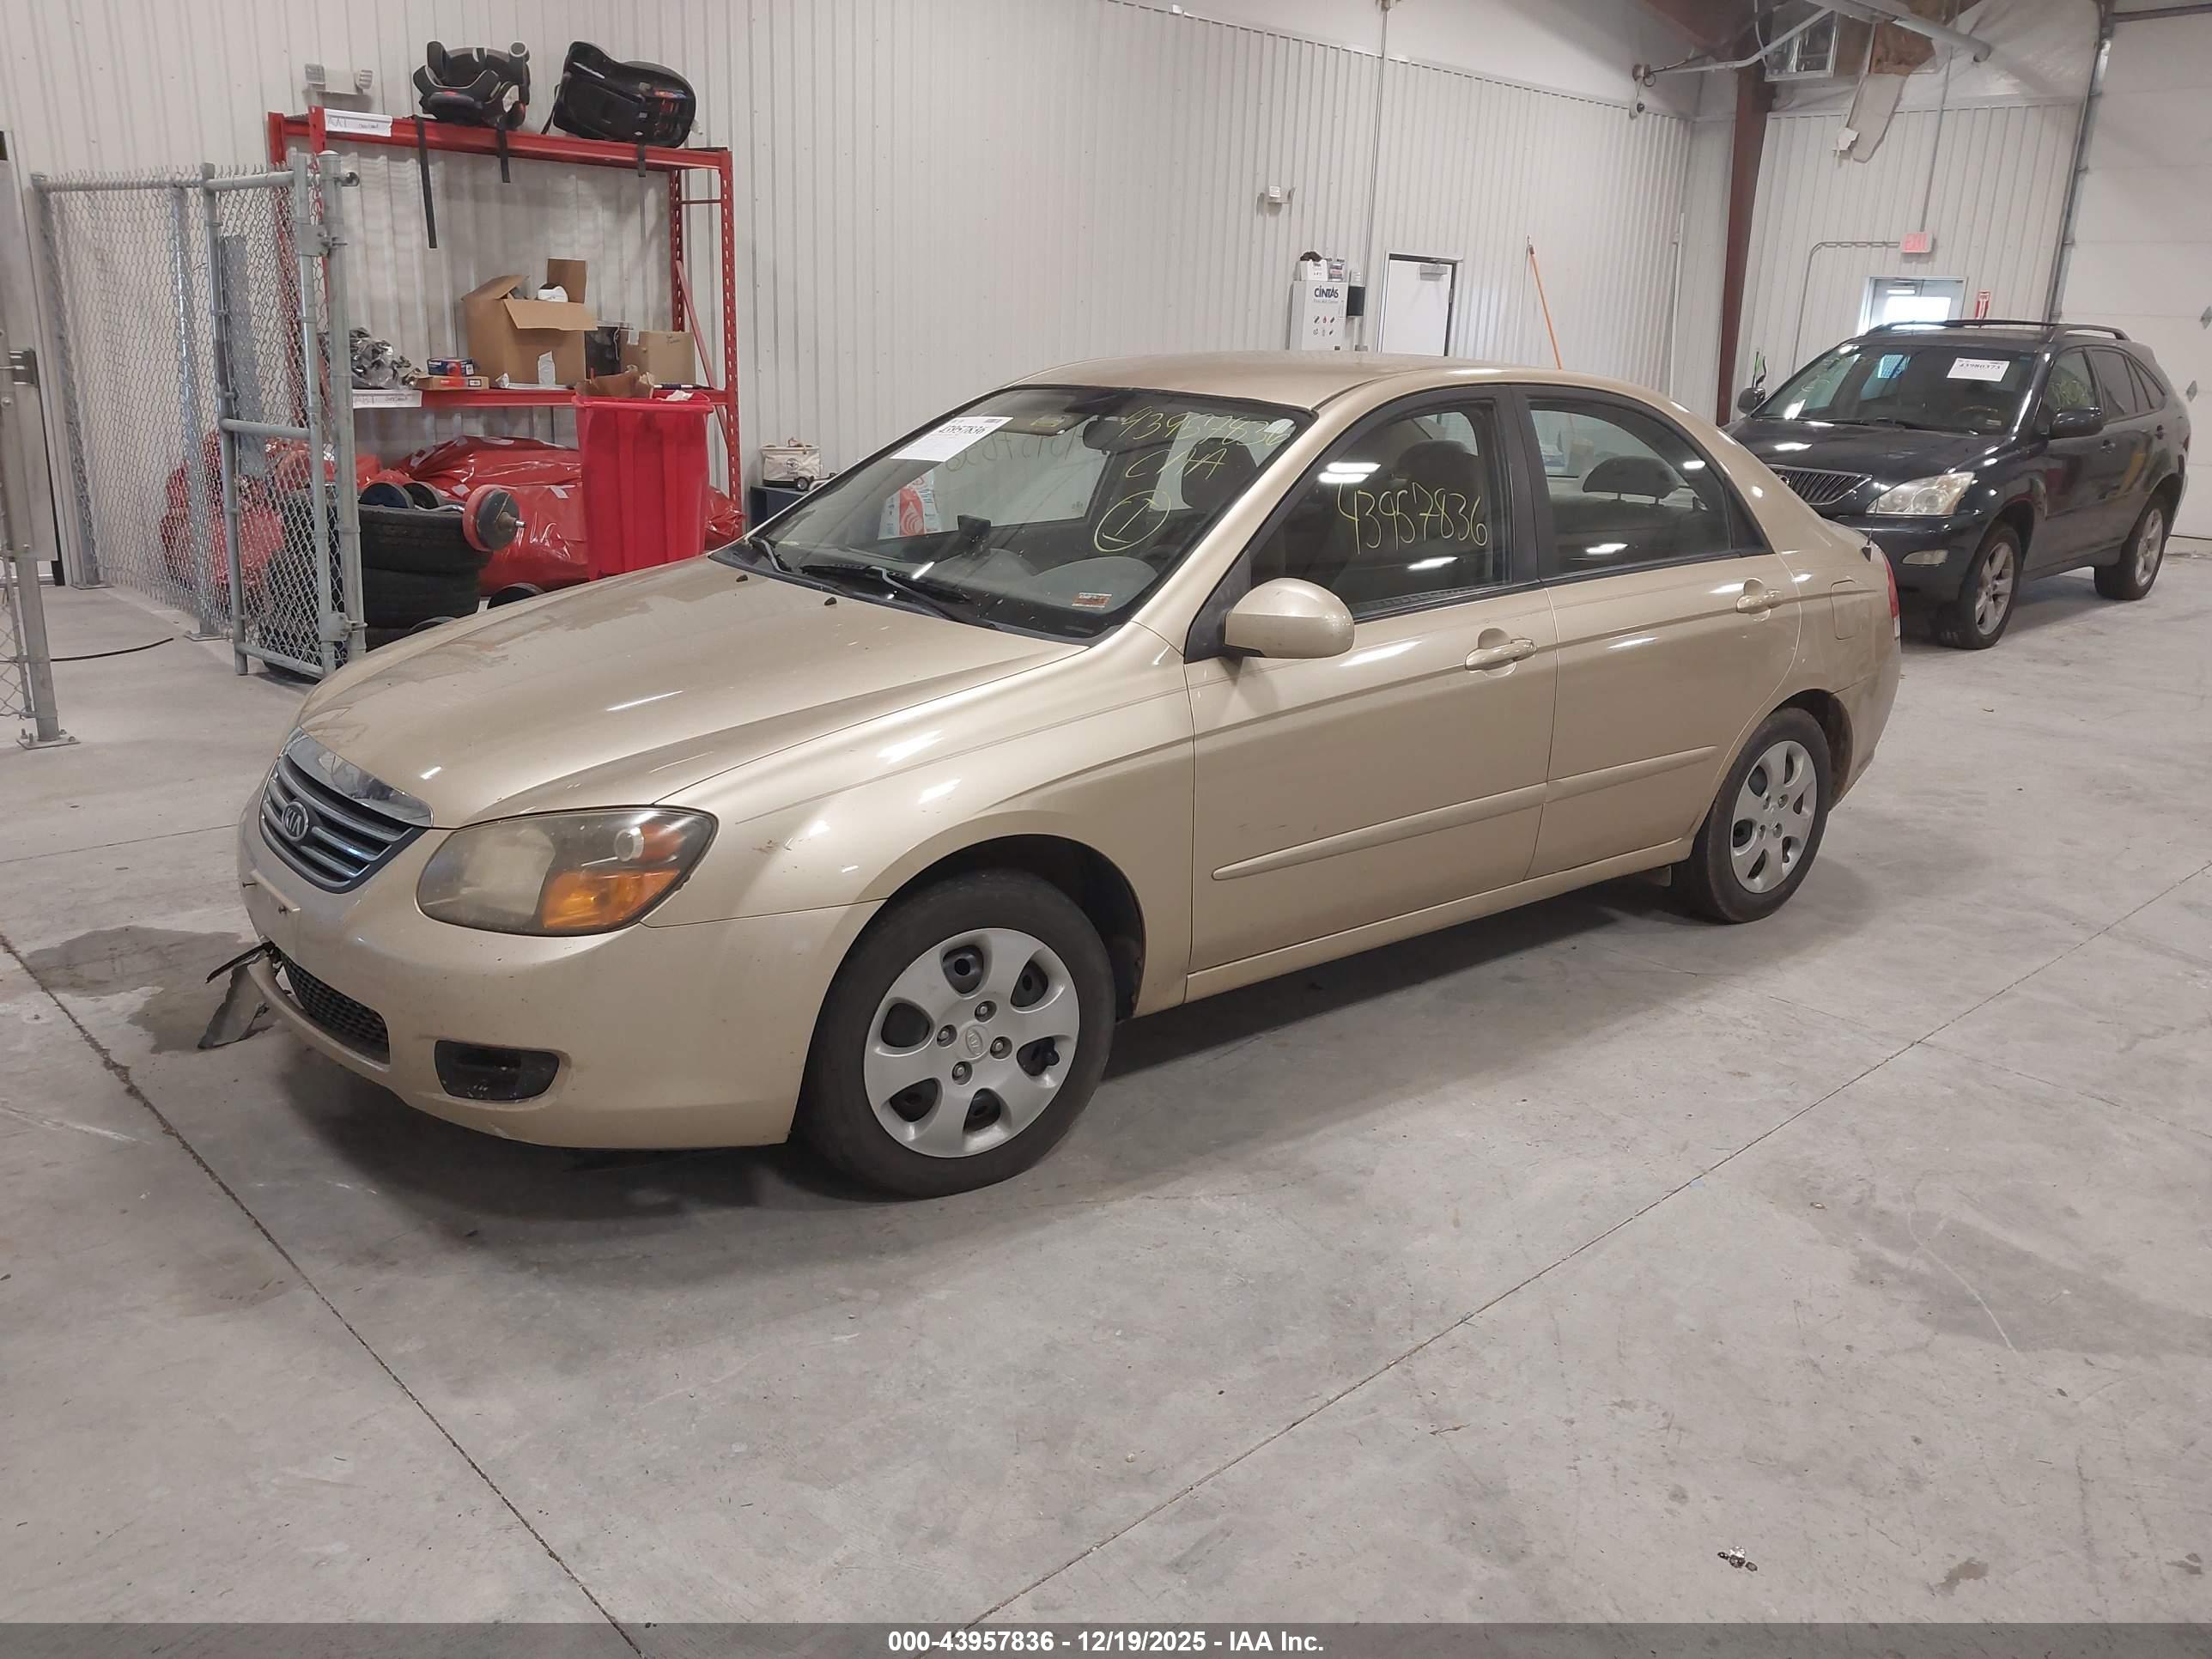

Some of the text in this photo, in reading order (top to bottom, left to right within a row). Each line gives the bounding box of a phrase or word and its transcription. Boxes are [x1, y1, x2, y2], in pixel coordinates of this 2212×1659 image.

[1314, 285, 1339, 298] CINTAS
[1119, 406, 1292, 447] 43957836
[1338, 482, 1488, 555] 43957836
